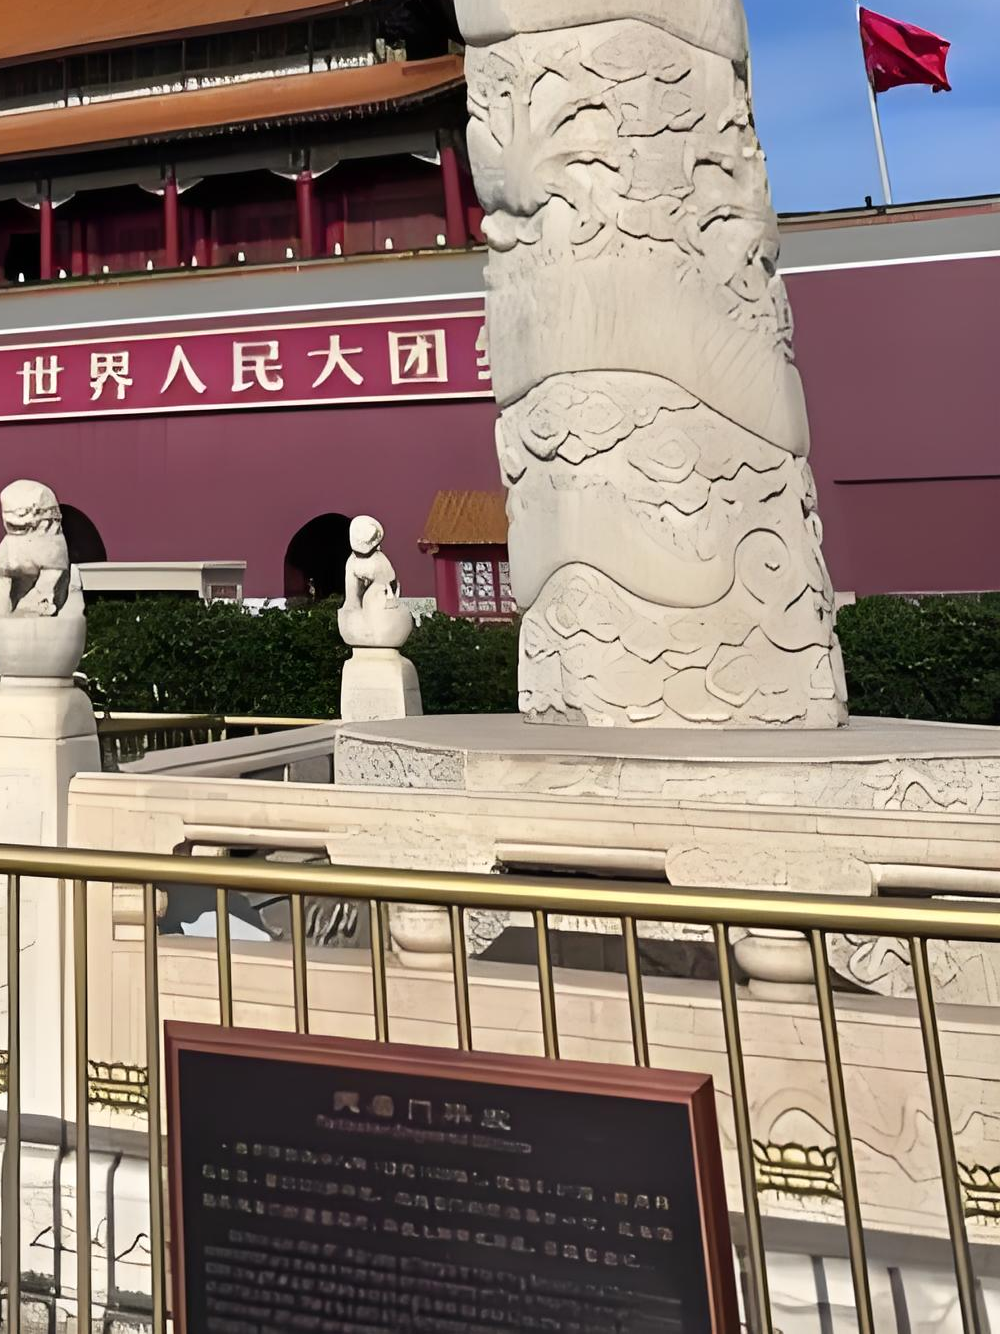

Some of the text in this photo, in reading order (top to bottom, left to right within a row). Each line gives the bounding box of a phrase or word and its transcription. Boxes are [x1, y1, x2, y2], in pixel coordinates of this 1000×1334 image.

[16, 325, 491, 404] 世界人民大团
